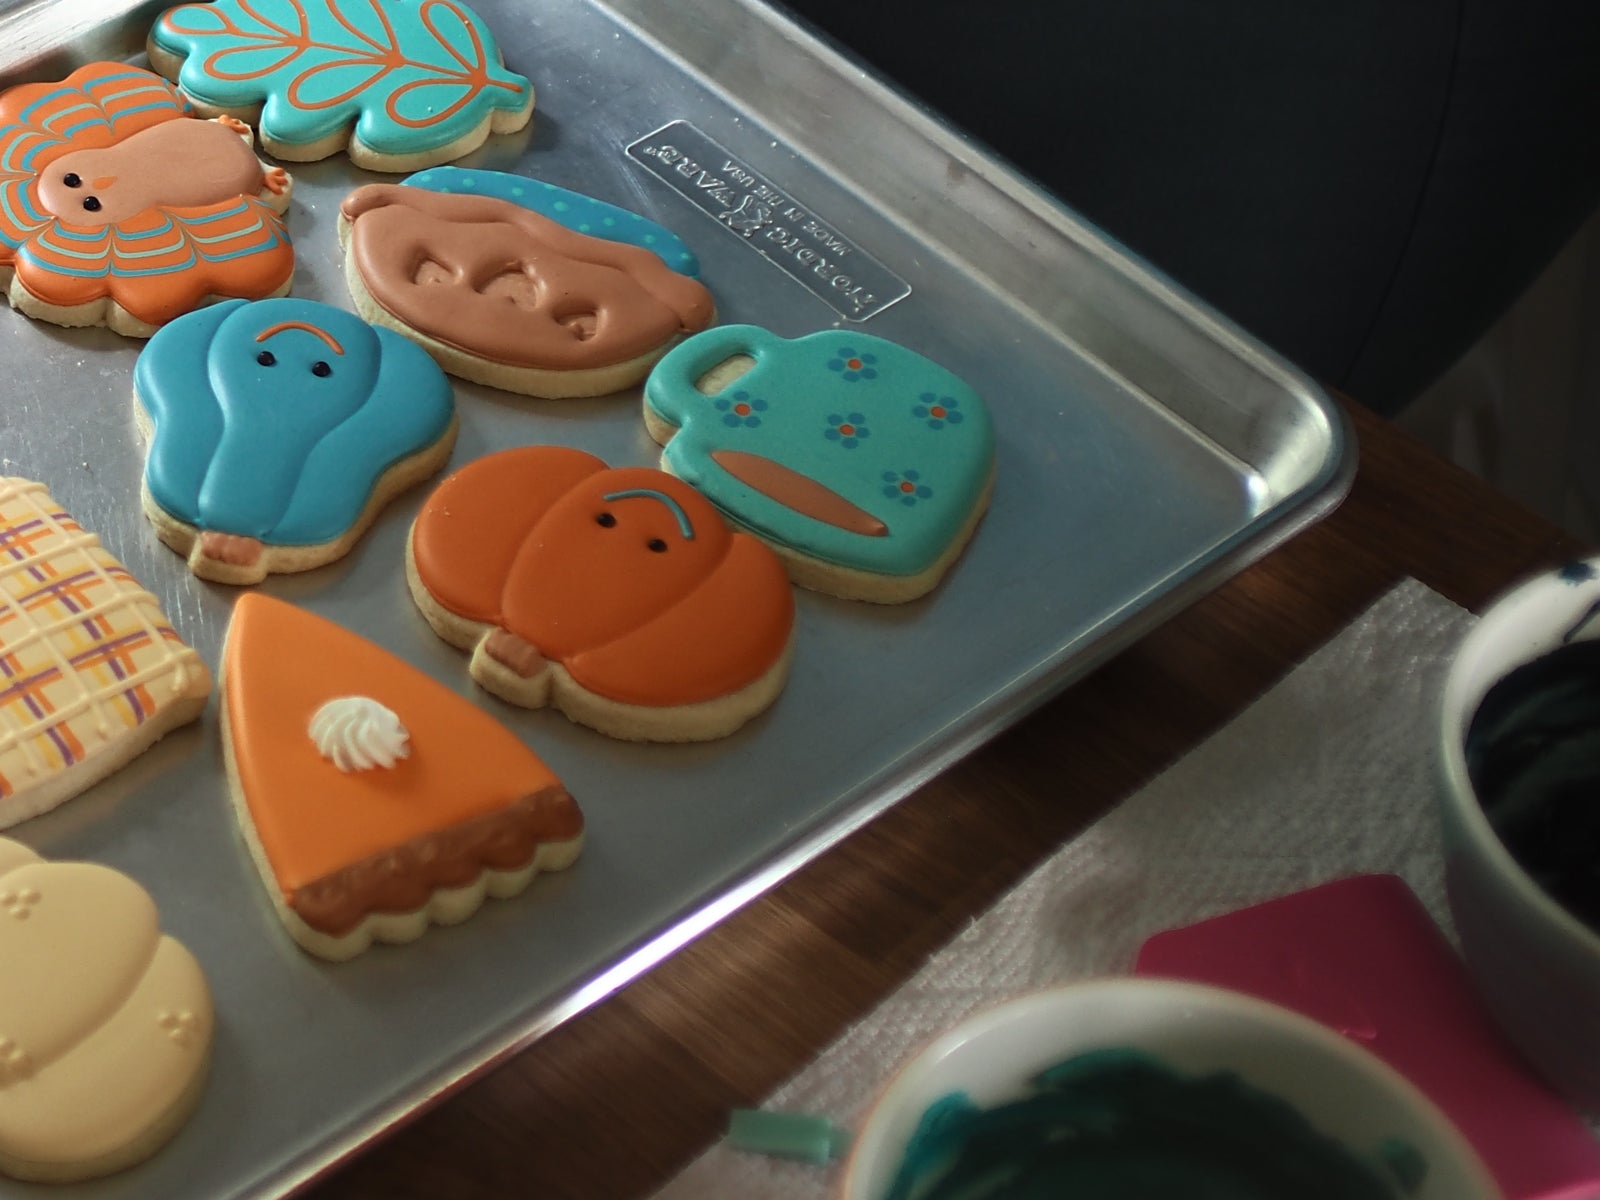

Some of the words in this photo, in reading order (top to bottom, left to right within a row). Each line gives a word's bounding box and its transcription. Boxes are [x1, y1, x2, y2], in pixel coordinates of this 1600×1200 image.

[721, 160, 755, 188] USA
[753, 184, 785, 206] THE
[784, 207, 805, 222] IN
[802, 221, 852, 256] MADE
[767, 226, 875, 312] NORDIC
